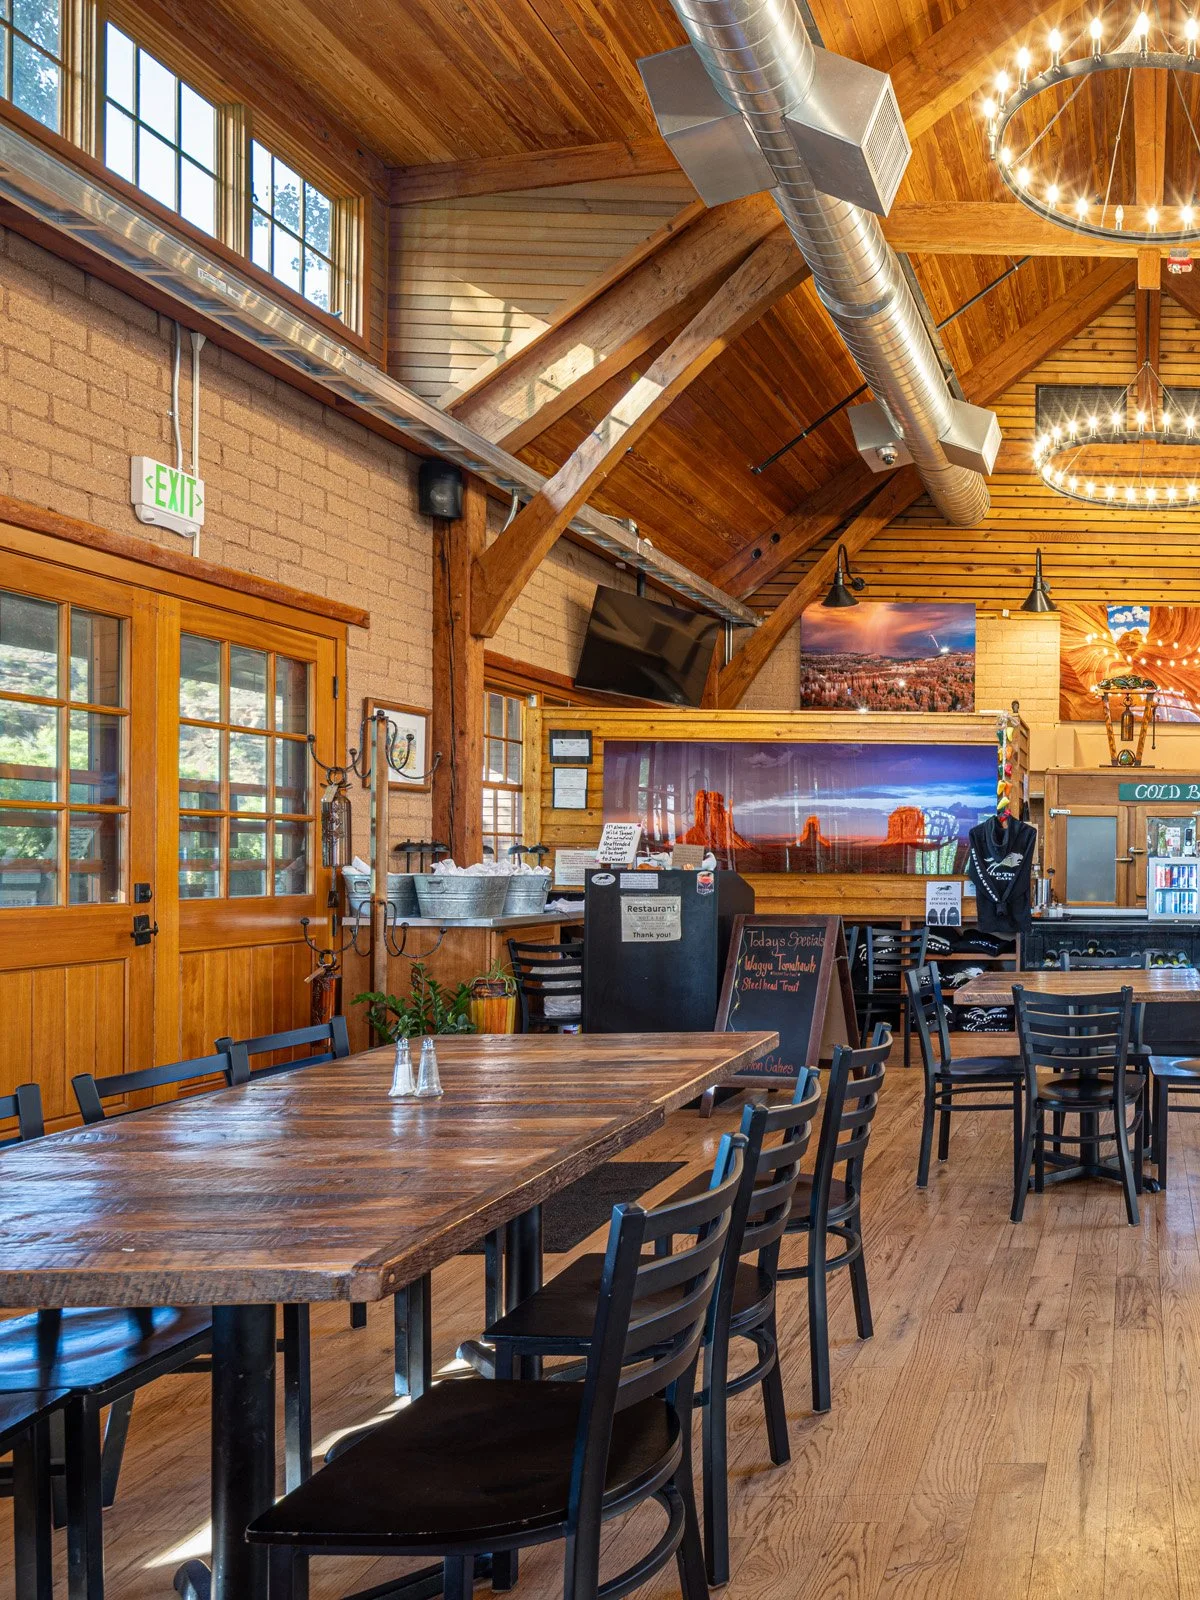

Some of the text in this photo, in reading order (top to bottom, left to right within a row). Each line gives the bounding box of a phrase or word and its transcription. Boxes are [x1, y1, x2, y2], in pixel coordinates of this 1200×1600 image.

[155, 463, 197, 518] EXIT
[1135, 784, 1181, 800] COLD
[627, 905, 677, 913] Restaurant
[787, 931, 826, 951] Specials
[744, 954, 773, 977] Wagyu
[741, 977, 800, 992] Steelhead Trout
[764, 1055, 794, 1074] Cakes
